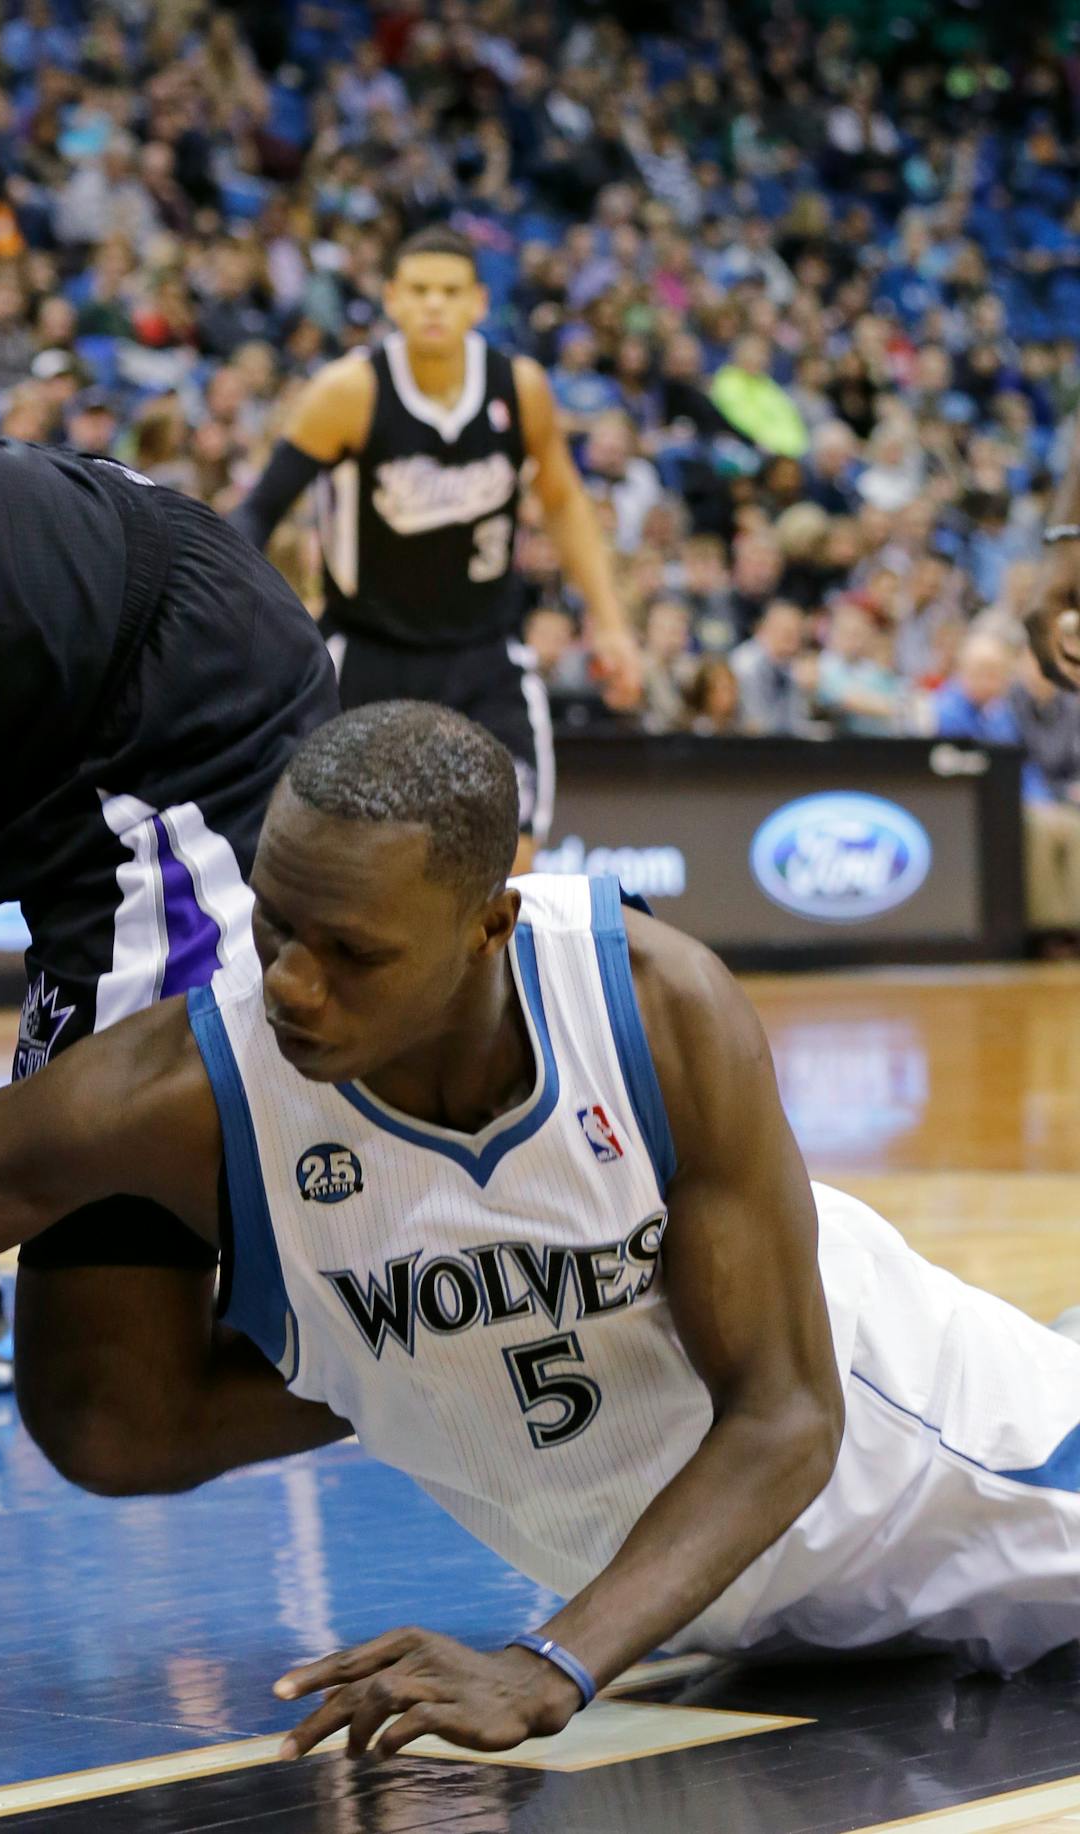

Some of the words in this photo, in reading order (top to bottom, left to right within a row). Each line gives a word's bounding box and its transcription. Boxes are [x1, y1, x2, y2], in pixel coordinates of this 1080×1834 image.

[467, 513, 514, 583] 3
[302, 1151, 356, 1191] 25
[318, 1210, 669, 1361] WOLVES
[501, 1331, 602, 1450] 5
